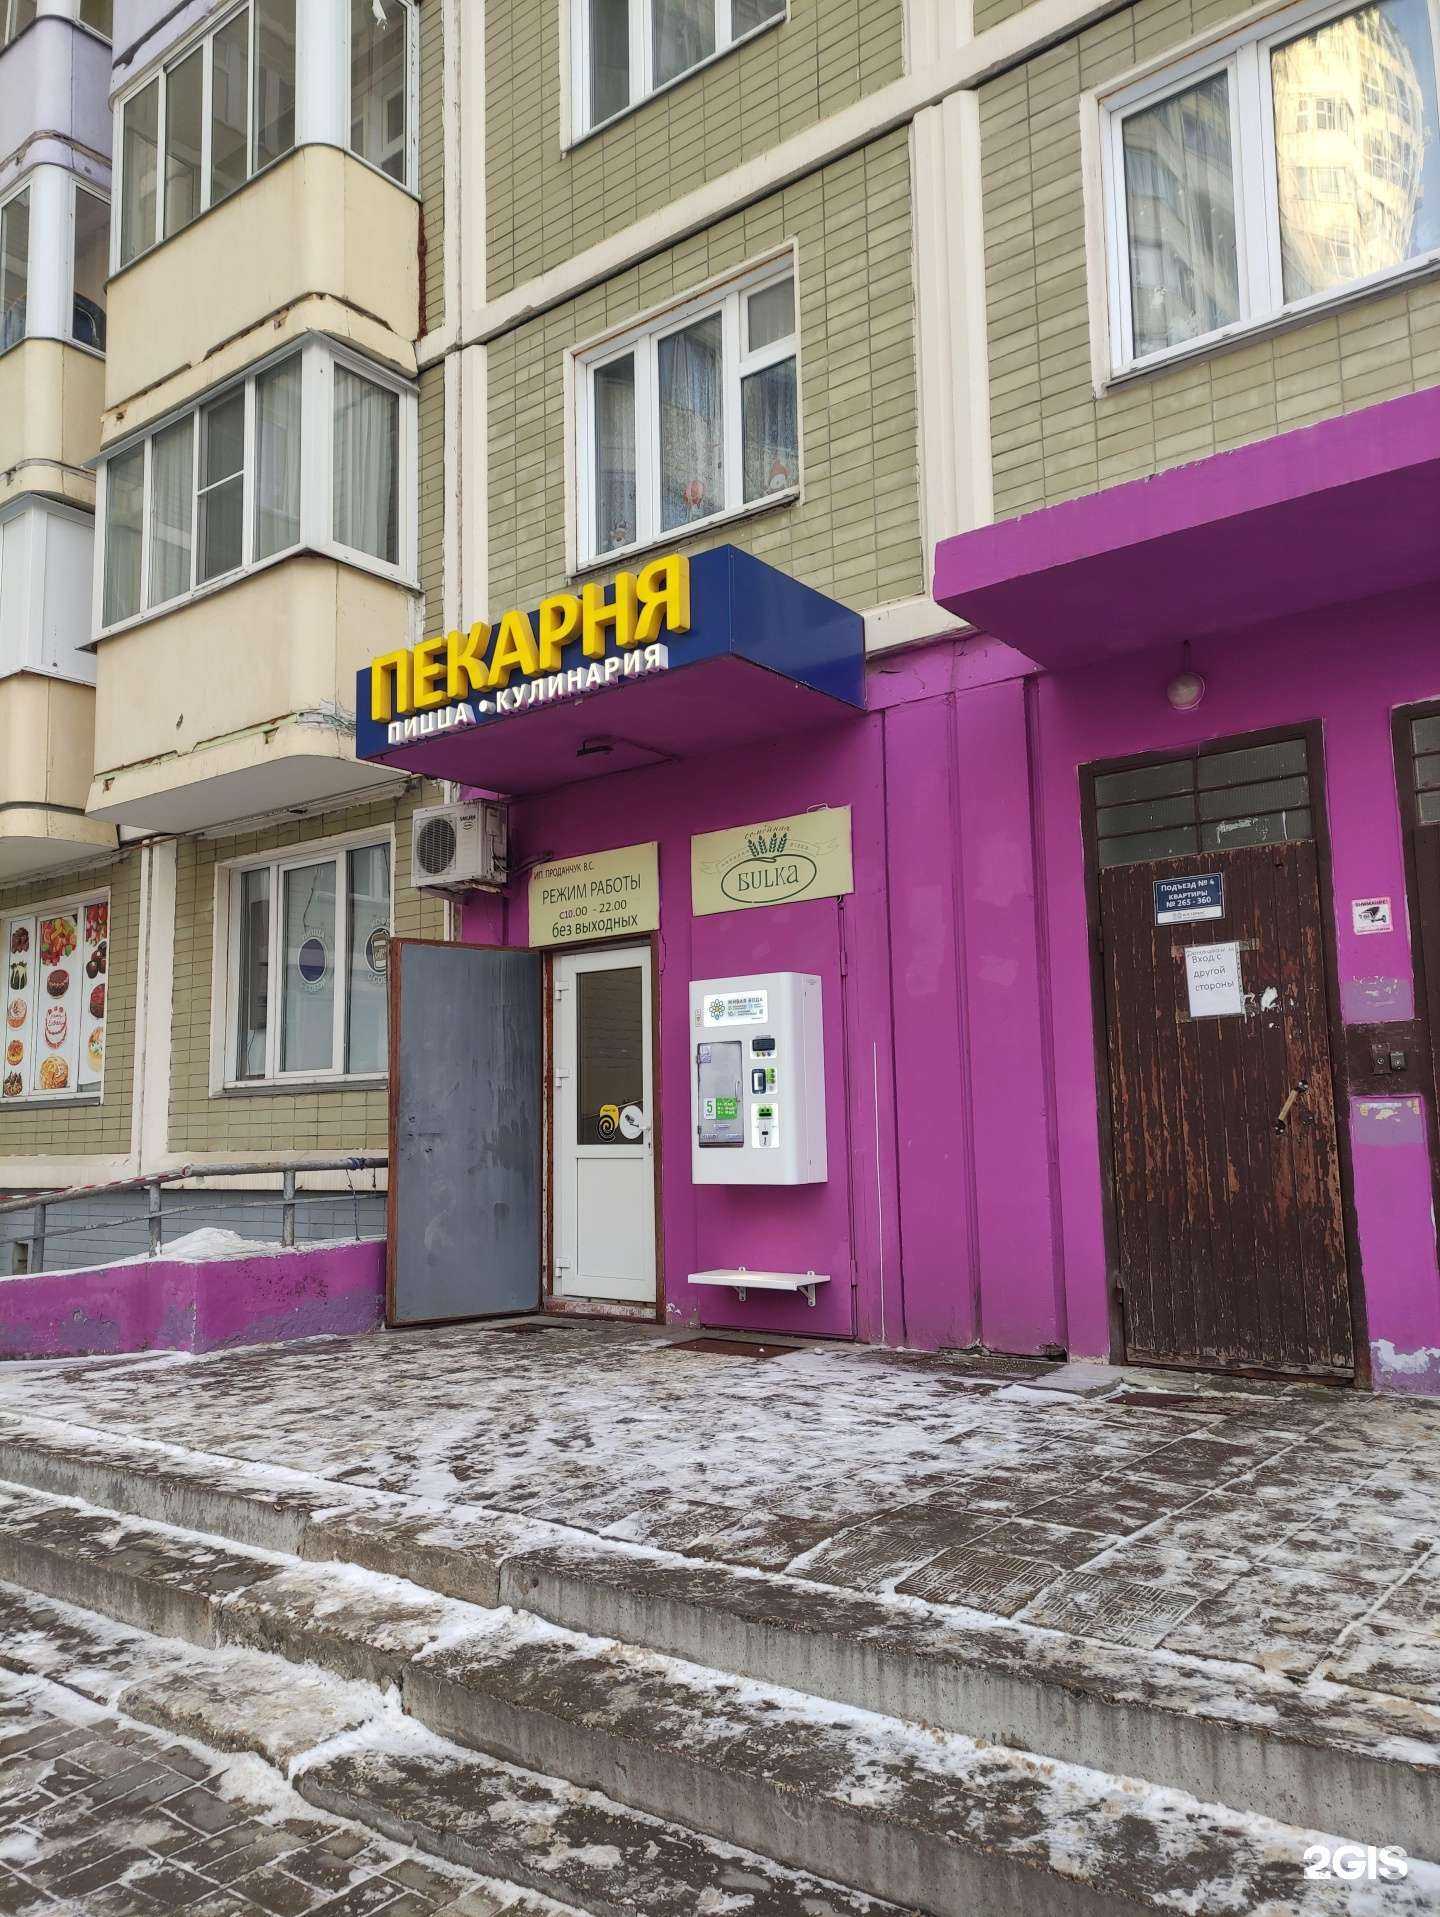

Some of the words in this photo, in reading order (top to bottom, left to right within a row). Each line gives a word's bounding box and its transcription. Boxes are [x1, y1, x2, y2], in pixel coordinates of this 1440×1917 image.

[371, 553, 691, 723] ПЕКАРНЯ
[387, 701, 475, 745] ПИЦЦА
[495, 642, 669, 715] КУЛИНАРИЯ
[546, 864, 582, 879] ПРОДАНЧУК
[542, 883, 587, 905] РЕЖИМ
[590, 873, 641, 898] РАБОТЫ
[1198, 879, 1208, 887] №
[599, 899, 627, 914] 22.00
[1166, 900, 1176, 908] №
[552, 921, 572, 938] без
[575, 914, 638, 935] выходных
[1191, 955, 1215, 964] Вход
[1194, 966, 1226, 979] другой
[1195, 981, 1234, 992] стороны
